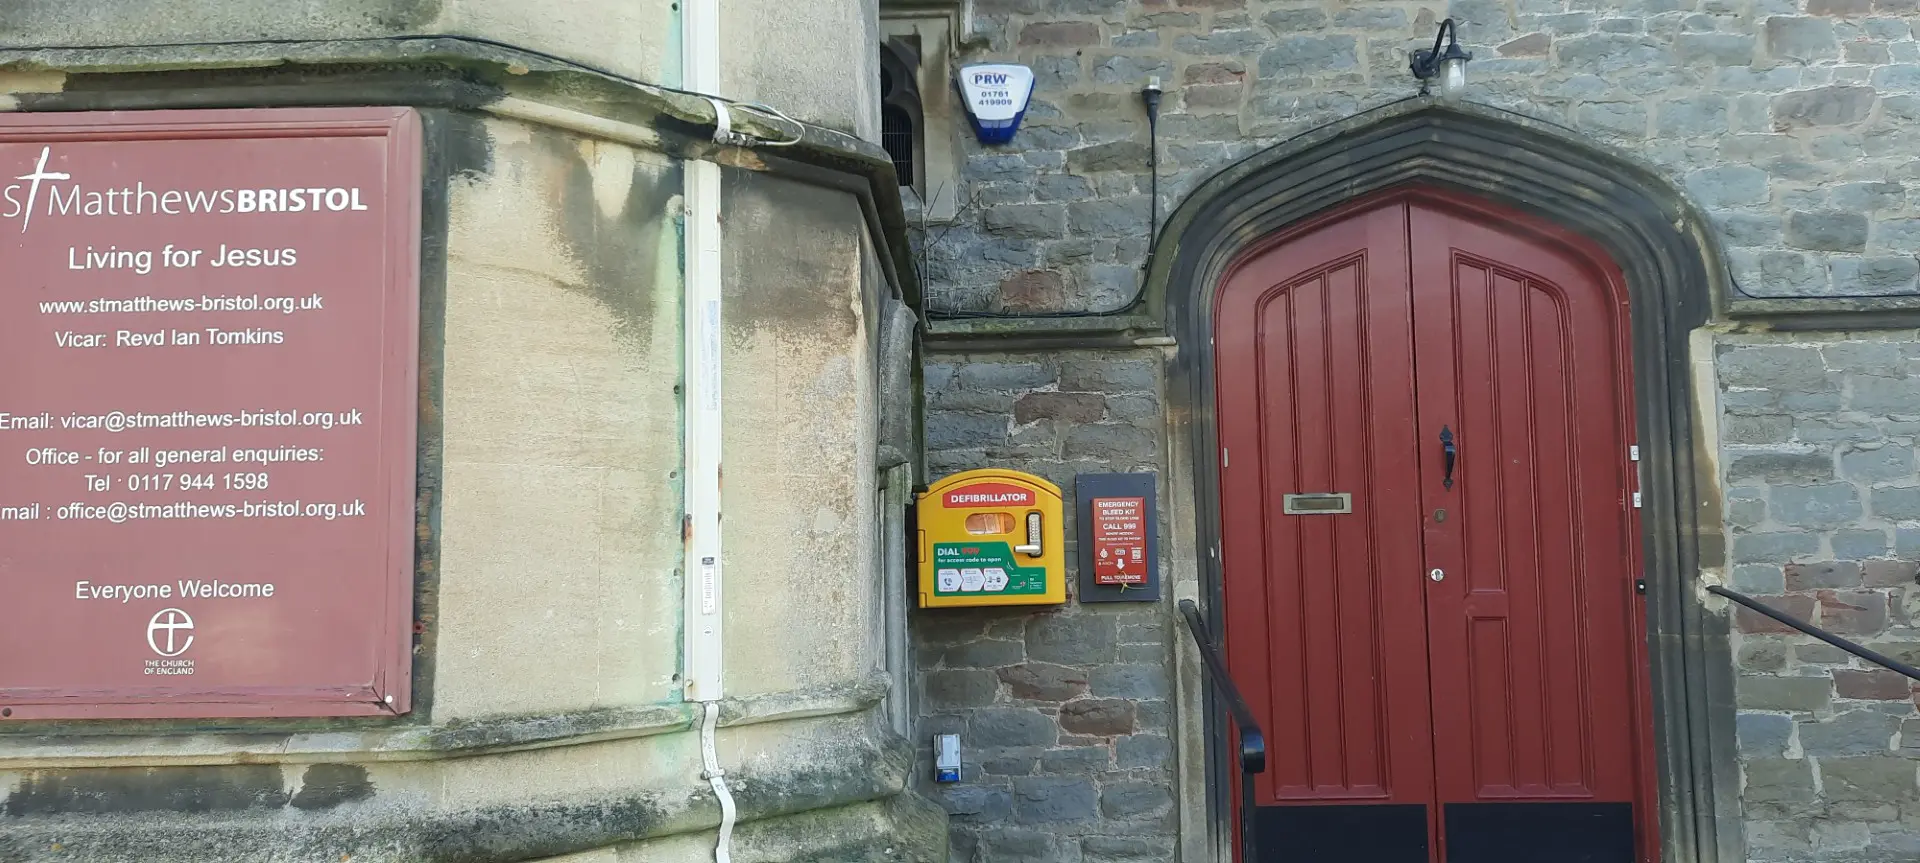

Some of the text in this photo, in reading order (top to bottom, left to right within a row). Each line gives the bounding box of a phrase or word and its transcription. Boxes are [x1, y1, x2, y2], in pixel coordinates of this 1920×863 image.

[974, 74, 1007, 85] PRW
[68, 243, 297, 275] Living for Jesus
[39, 292, 323, 315] www.stmatthews-bristol.org.uk
[54, 327, 284, 348] Vicar: Revd Ian Tomkins
[0, 408, 363, 433] Email: vicar@stmatthews-bristol.org.uk
[25, 447, 80, 465] Office
[97, 447, 124, 464] for
[127, 446, 150, 464] all
[154, 445, 227, 468] general
[232, 444, 324, 467] enquiries:
[84, 474, 110, 492] Tel
[127, 473, 174, 491] 0117
[179, 473, 216, 491] 944
[223, 472, 269, 490] 1598
[951, 493, 1027, 503] DEFIBRILLATOR
[0, 502, 40, 520] mail
[56, 498, 366, 524] office@stmatthews-bristol.org.uk
[937, 548, 960, 556] DIAL
[75, 579, 275, 604] Everyone Welcome
